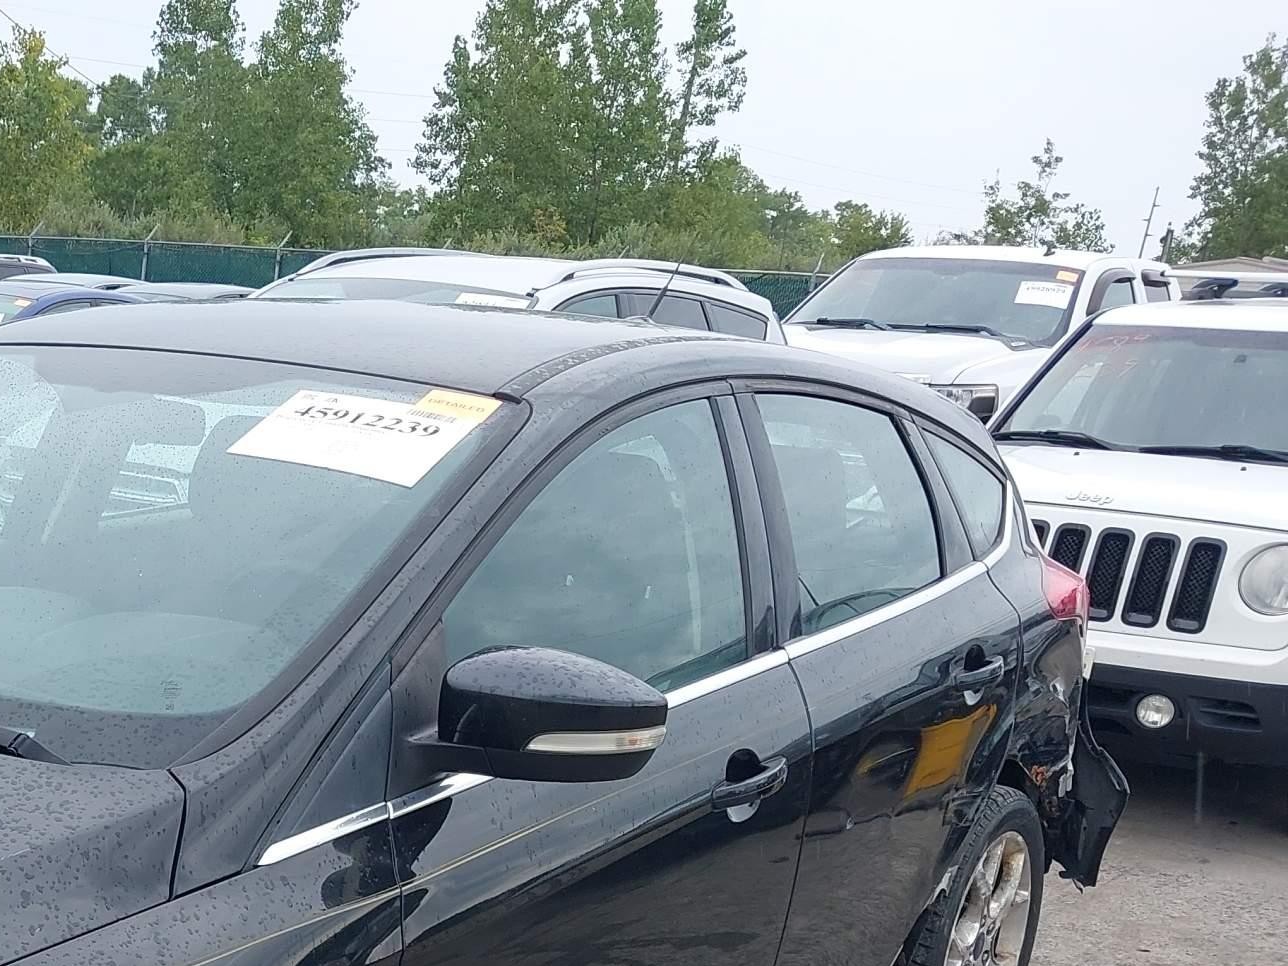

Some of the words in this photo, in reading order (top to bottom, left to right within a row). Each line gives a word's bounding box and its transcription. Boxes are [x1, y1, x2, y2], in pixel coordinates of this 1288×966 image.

[427, 398, 486, 413] DETAILED
[294, 405, 441, 437] 45912239
[1064, 489, 1114, 506] Jeep
